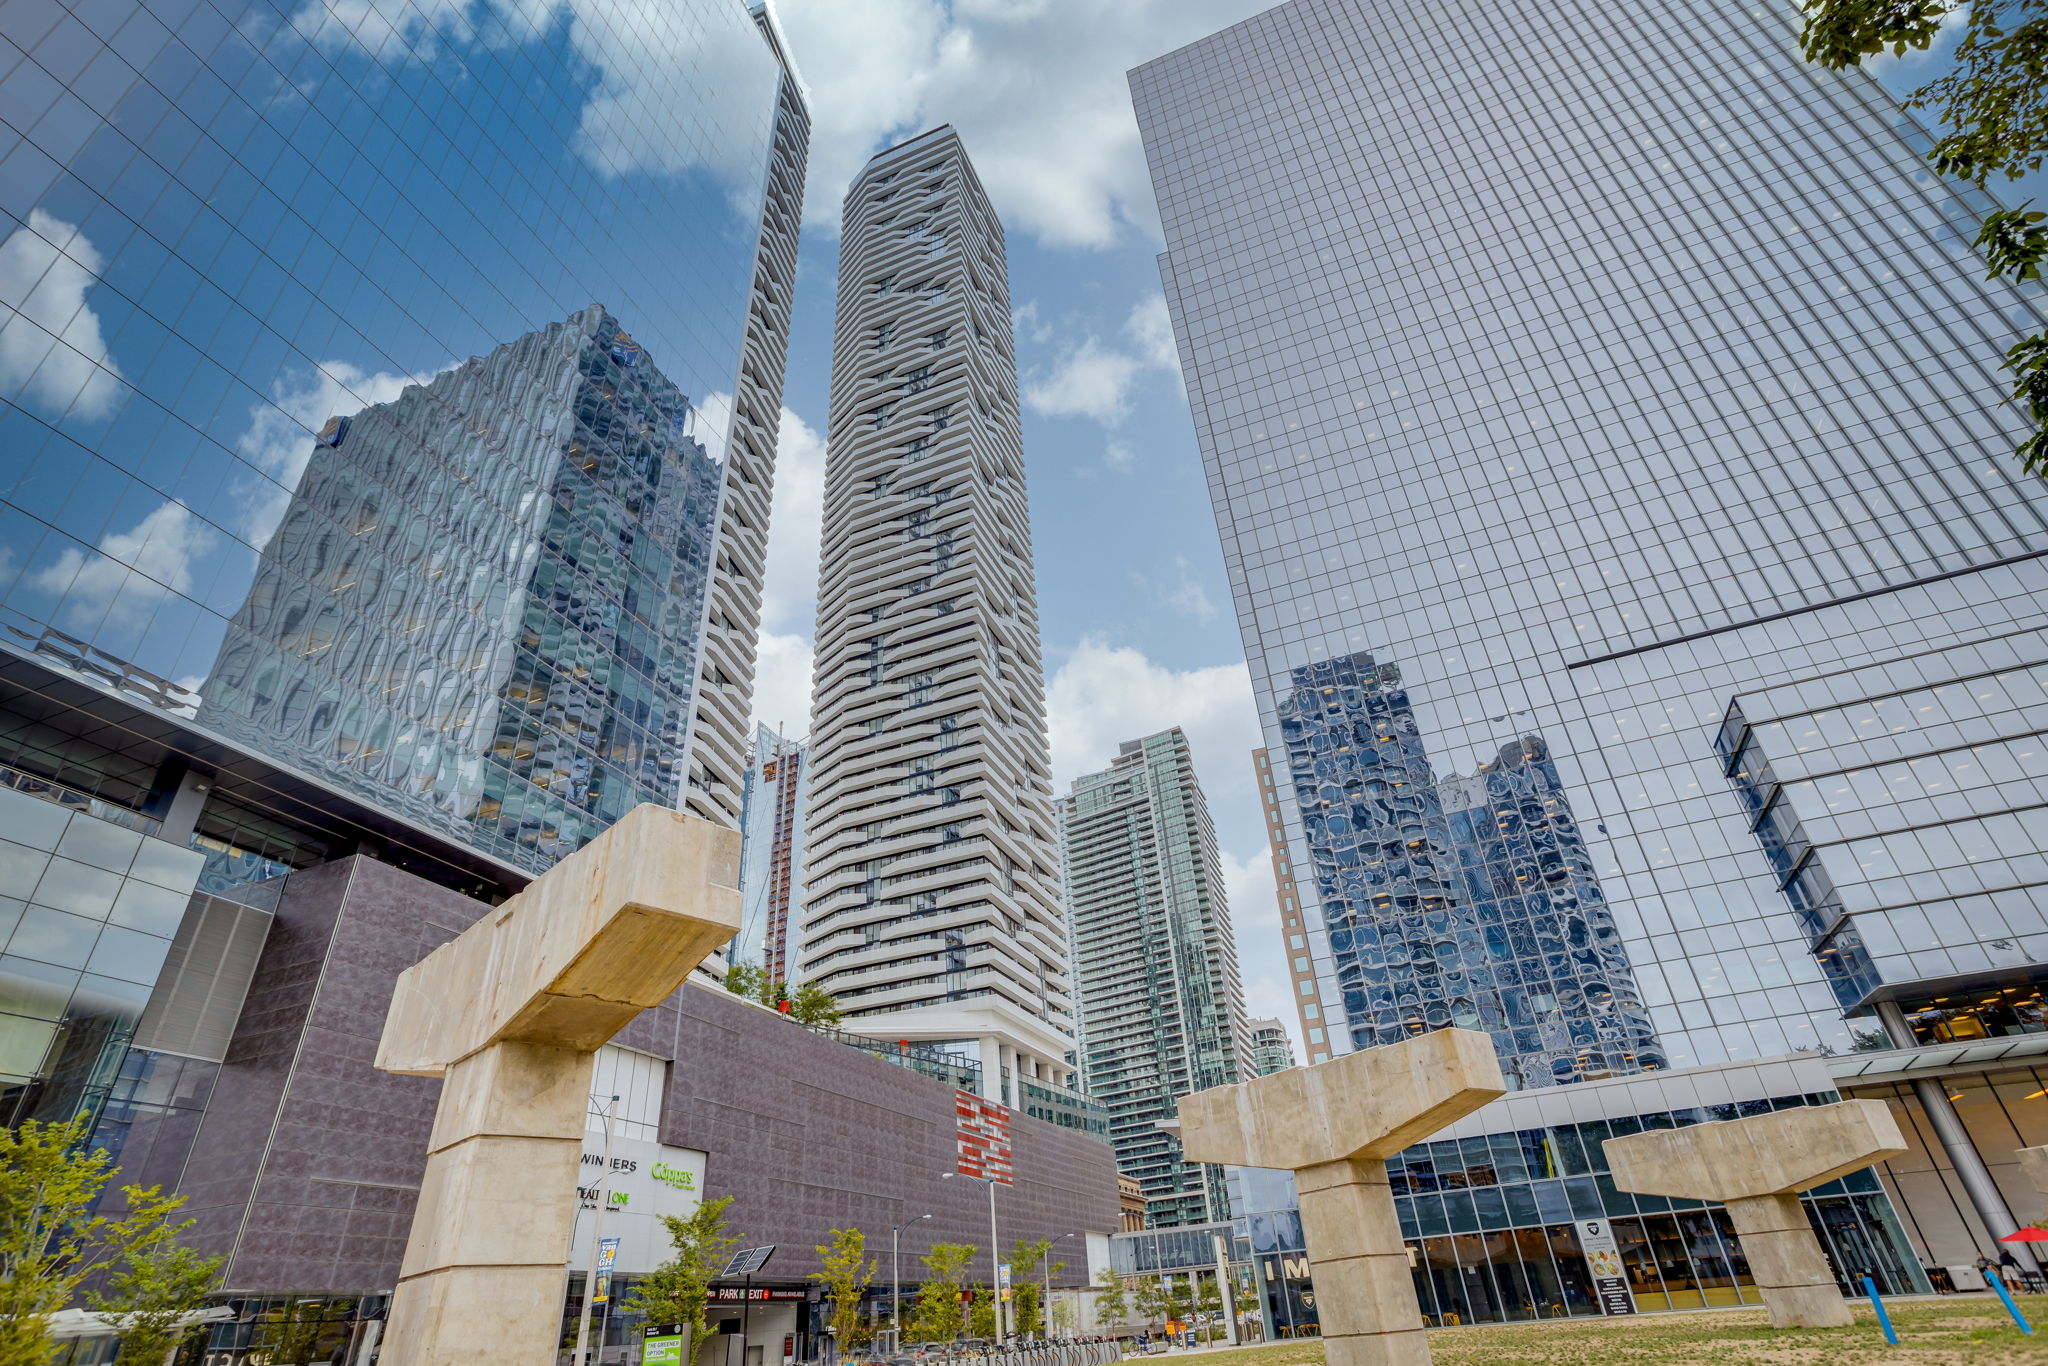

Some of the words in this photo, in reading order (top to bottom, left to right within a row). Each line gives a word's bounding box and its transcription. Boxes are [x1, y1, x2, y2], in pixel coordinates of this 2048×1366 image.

[719, 1288, 739, 1300] PARK
[748, 1289, 764, 1299] EXIT
[657, 1340, 680, 1348] GREENER
